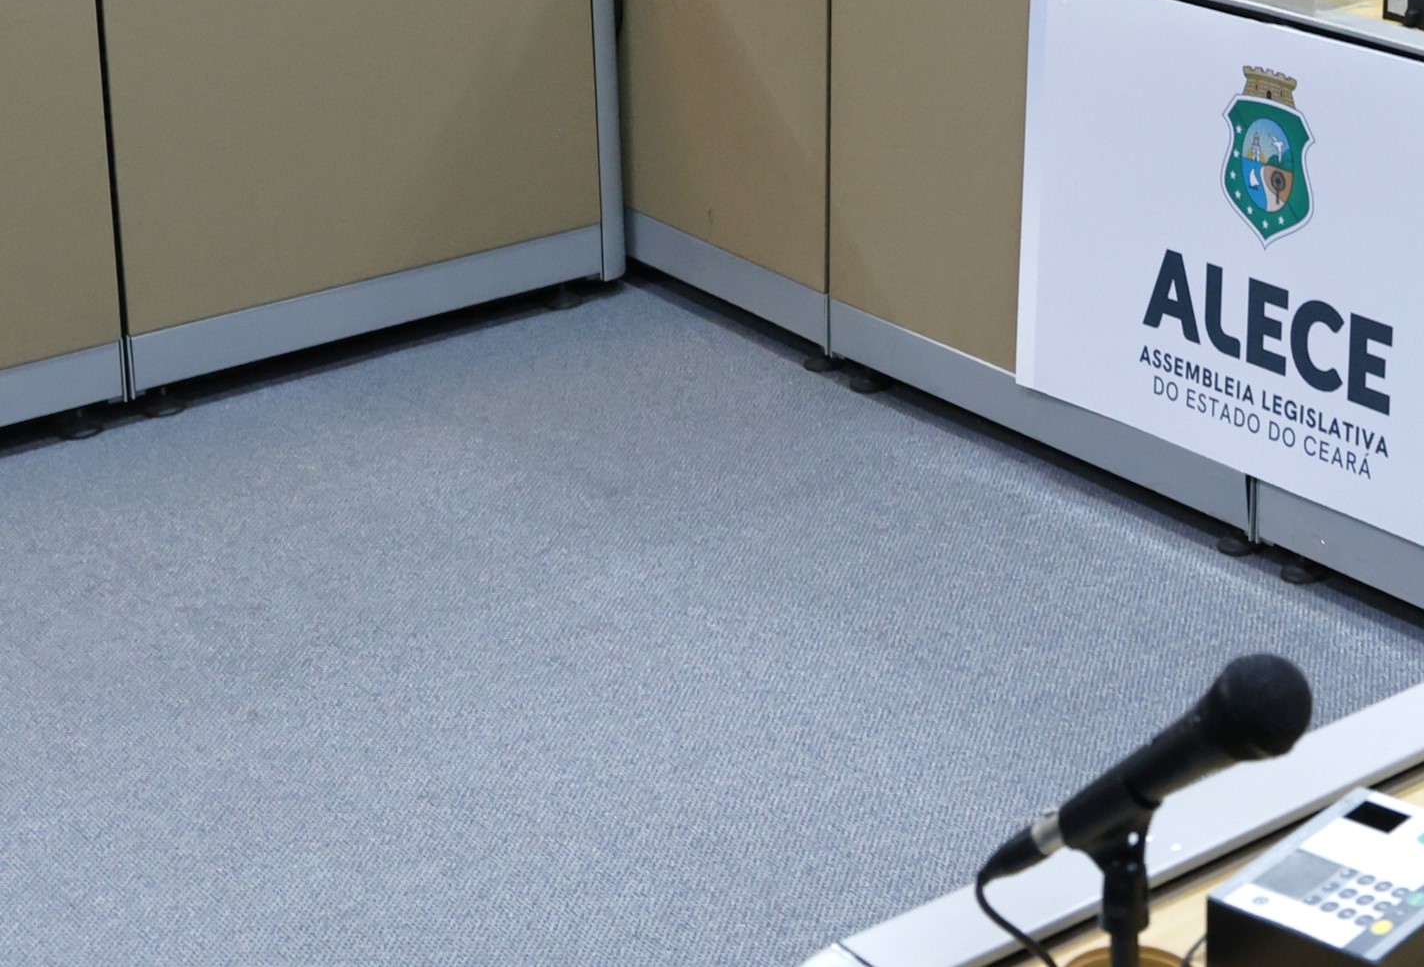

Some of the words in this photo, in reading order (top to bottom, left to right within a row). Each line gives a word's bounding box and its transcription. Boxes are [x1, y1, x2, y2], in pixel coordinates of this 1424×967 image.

[1142, 249, 1393, 416] ALECE
[1139, 345, 1254, 405] ASSEMBLEIA
[1262, 390, 1388, 459] LEGISLATIVA
[1153, 376, 1178, 401] DO
[1186, 391, 1260, 435] ESTADO
[1268, 421, 1296, 449] DO
[1303, 435, 1372, 479] CEARÁ
